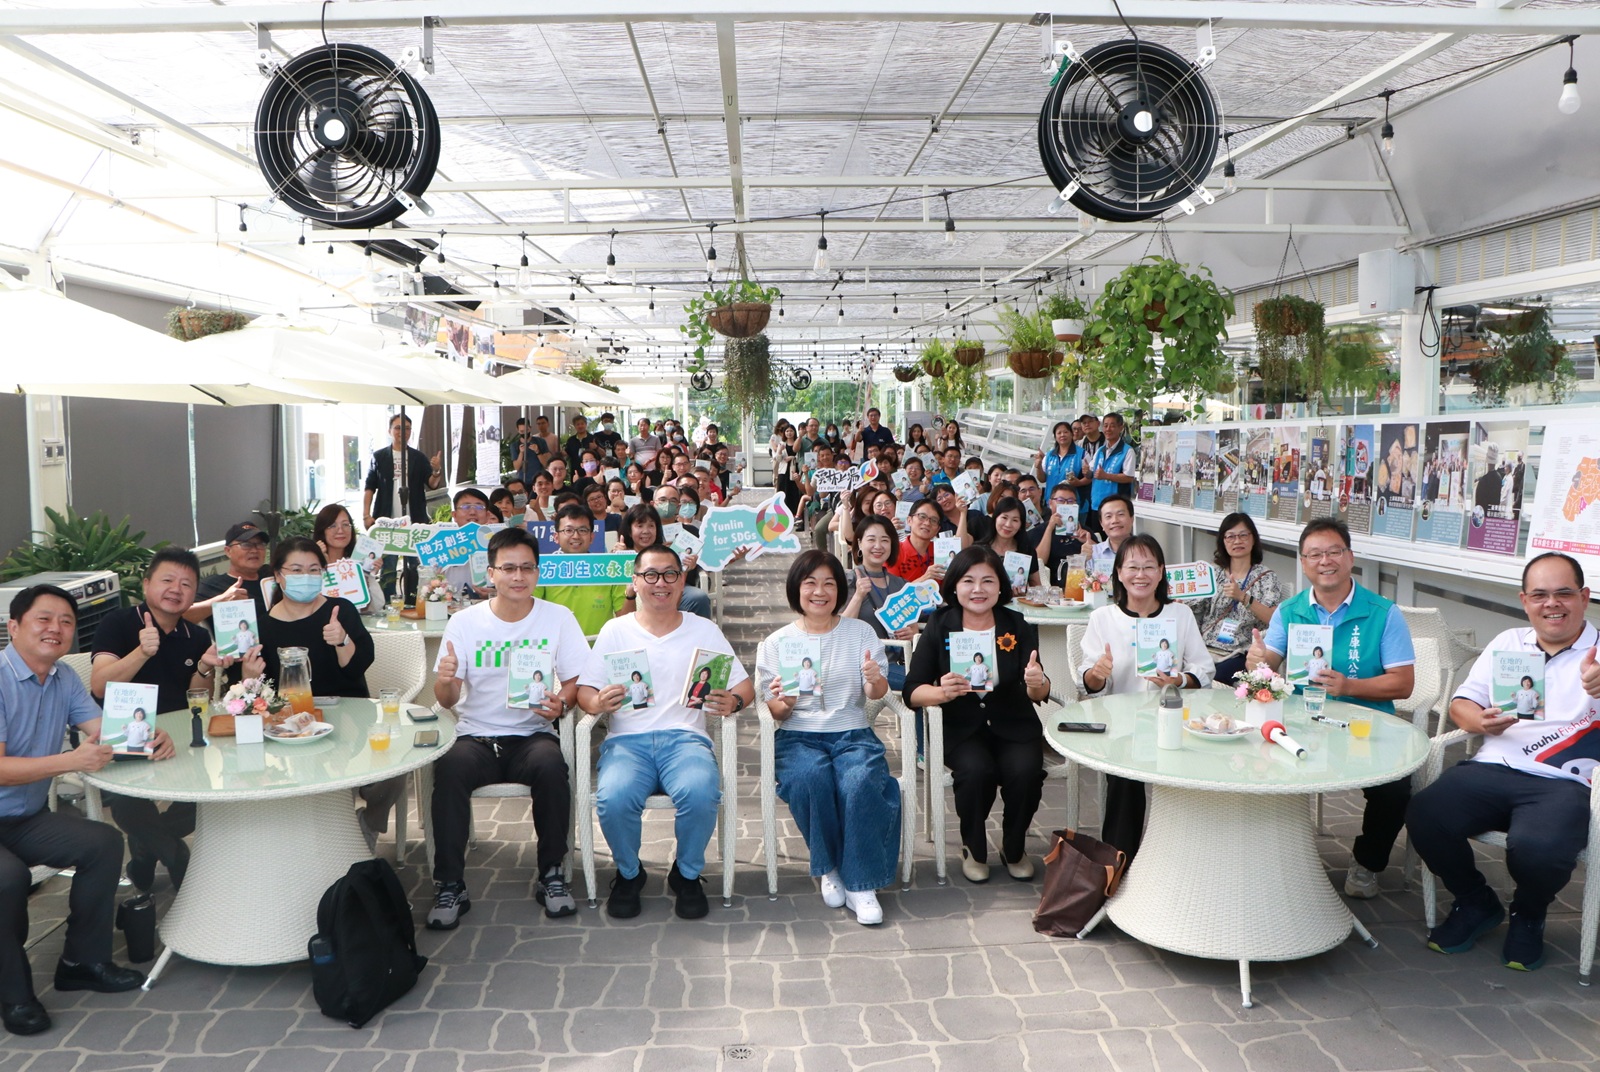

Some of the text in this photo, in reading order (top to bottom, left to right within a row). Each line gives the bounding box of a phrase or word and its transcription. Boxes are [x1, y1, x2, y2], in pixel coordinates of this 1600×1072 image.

[532, 525, 546, 539] 17
[711, 520, 744, 533] Yunlin
[713, 531, 757, 546] for SDGs
[448, 539, 479, 559] No.1
[1521, 707, 1597, 756] Kouhu Fisheris
